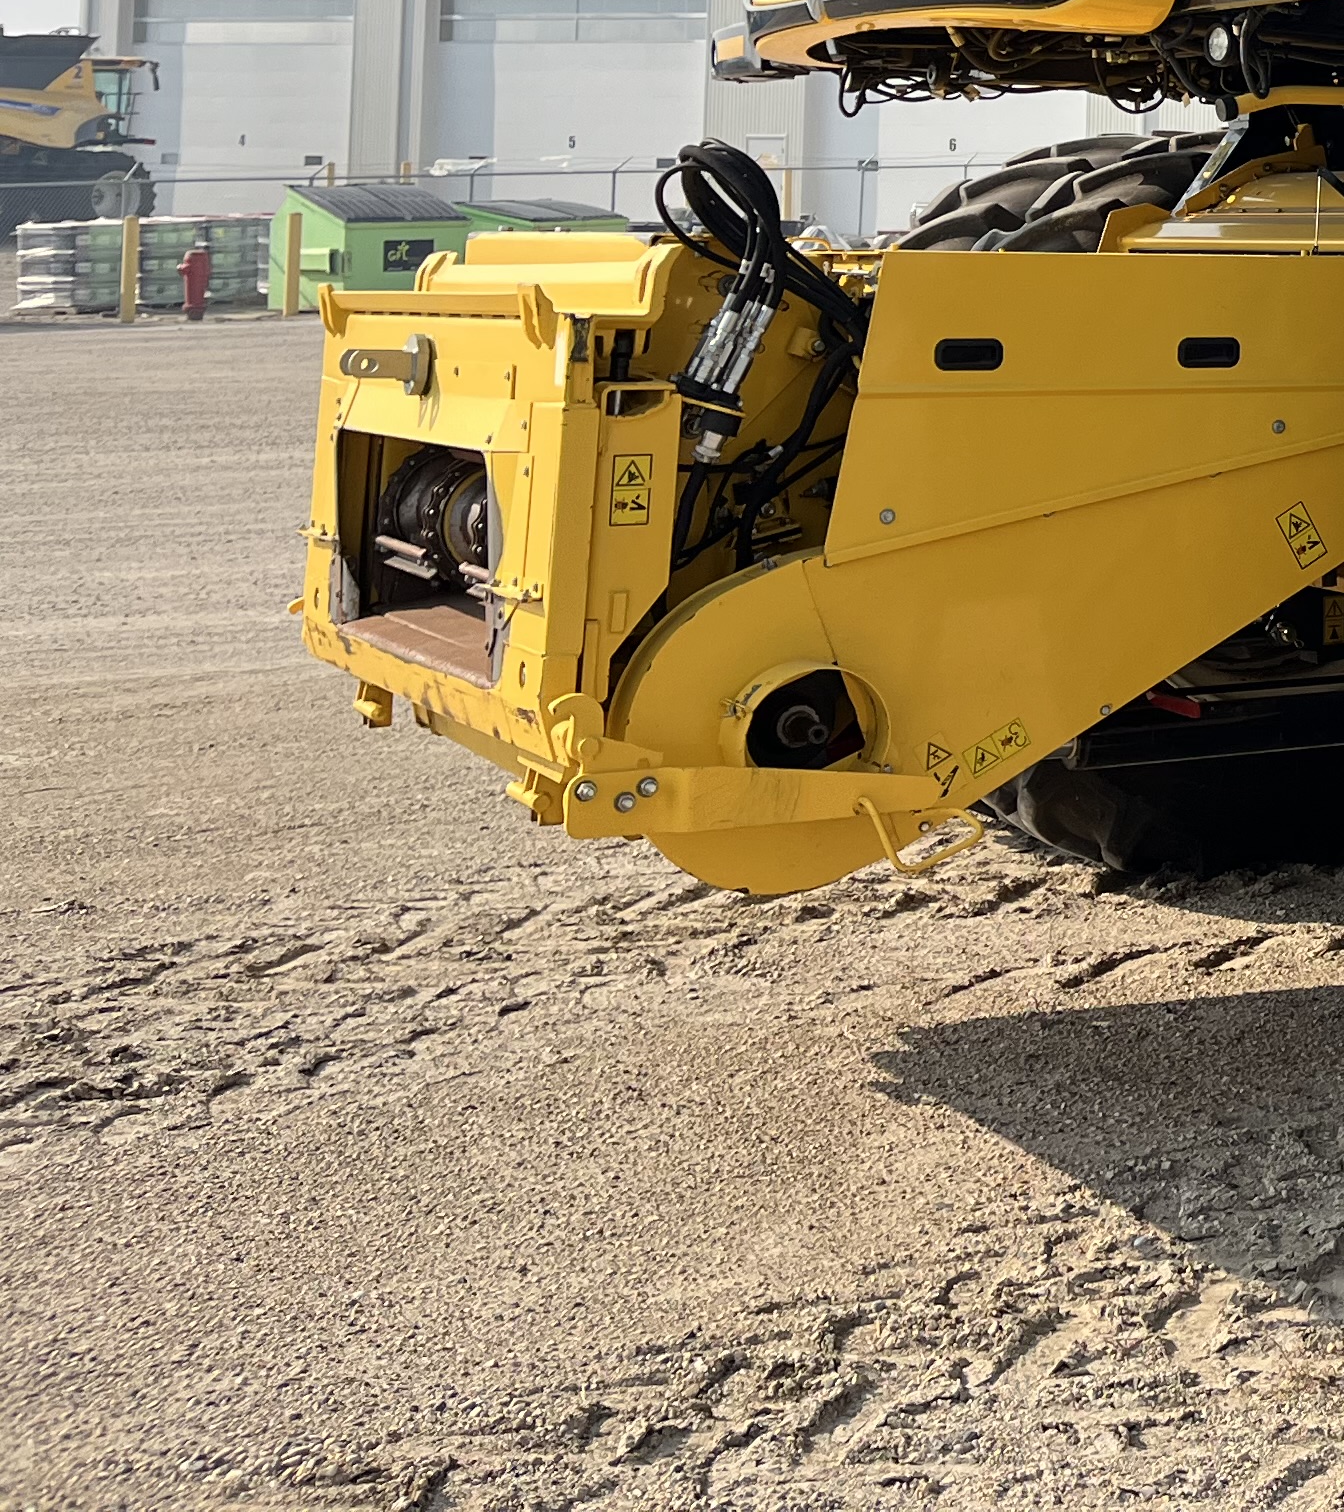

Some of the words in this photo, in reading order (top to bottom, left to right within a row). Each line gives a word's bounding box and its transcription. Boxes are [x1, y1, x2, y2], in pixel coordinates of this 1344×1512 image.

[237, 134, 246, 147] 4
[568, 135, 576, 149] 5
[949, 138, 957, 152] 6
